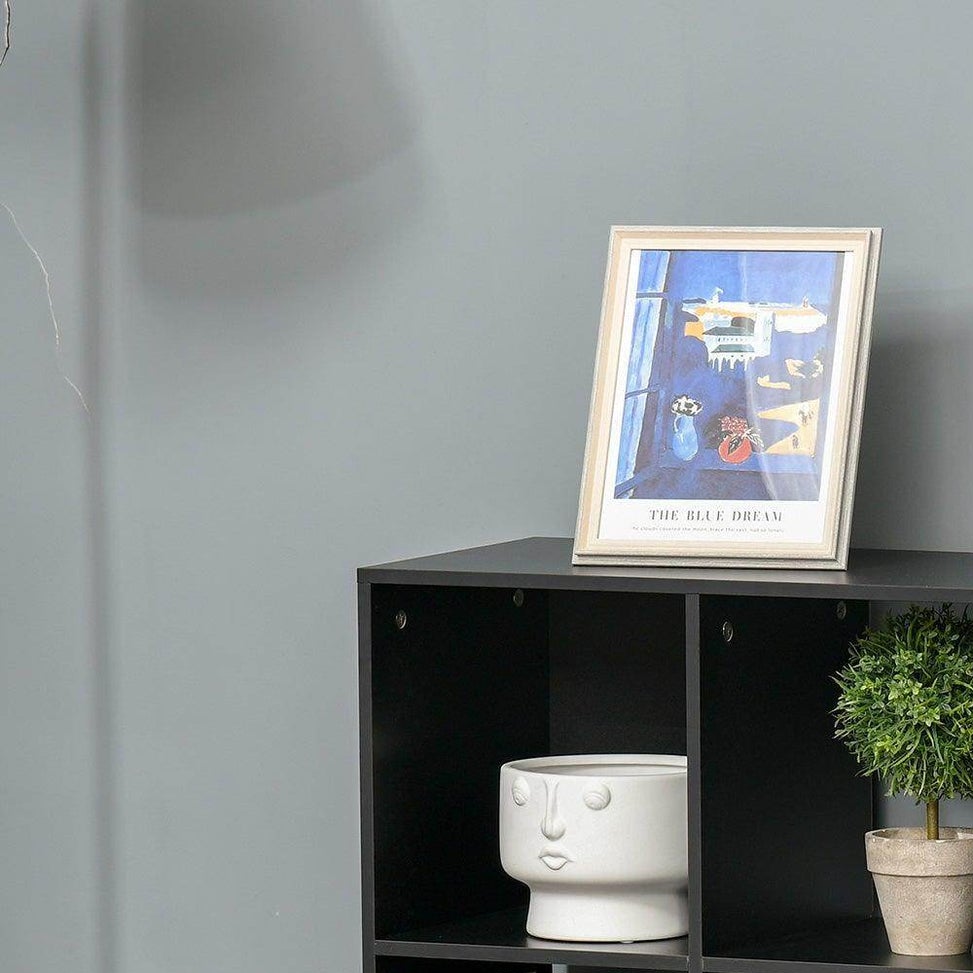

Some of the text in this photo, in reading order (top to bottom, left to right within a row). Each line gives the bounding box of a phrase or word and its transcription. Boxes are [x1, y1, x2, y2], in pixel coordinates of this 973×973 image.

[649, 509, 783, 522] THE BLUE DREAM
